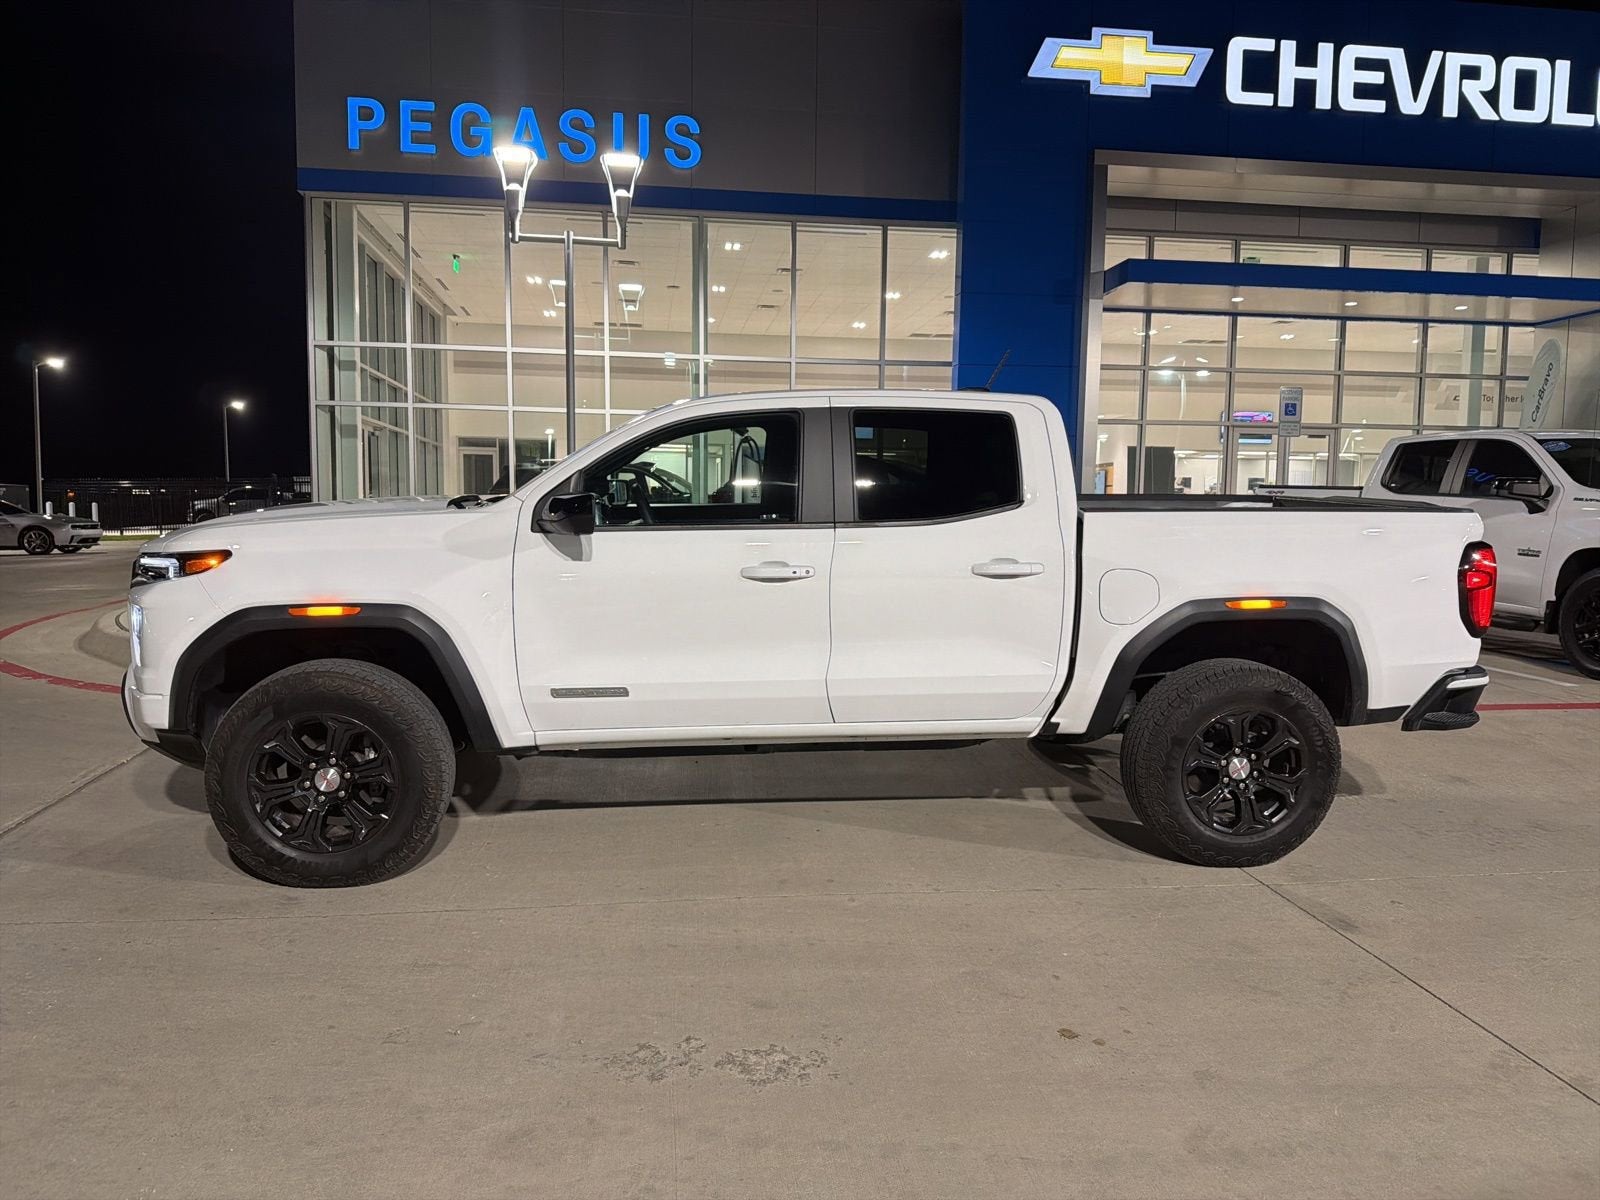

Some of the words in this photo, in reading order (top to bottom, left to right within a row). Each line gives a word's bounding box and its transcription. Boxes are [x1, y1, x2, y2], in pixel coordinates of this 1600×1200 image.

[1225, 36, 1600, 127] CHEVROL
[347, 97, 702, 169] PEGASUS
[1531, 362, 1553, 422] CarBravo
